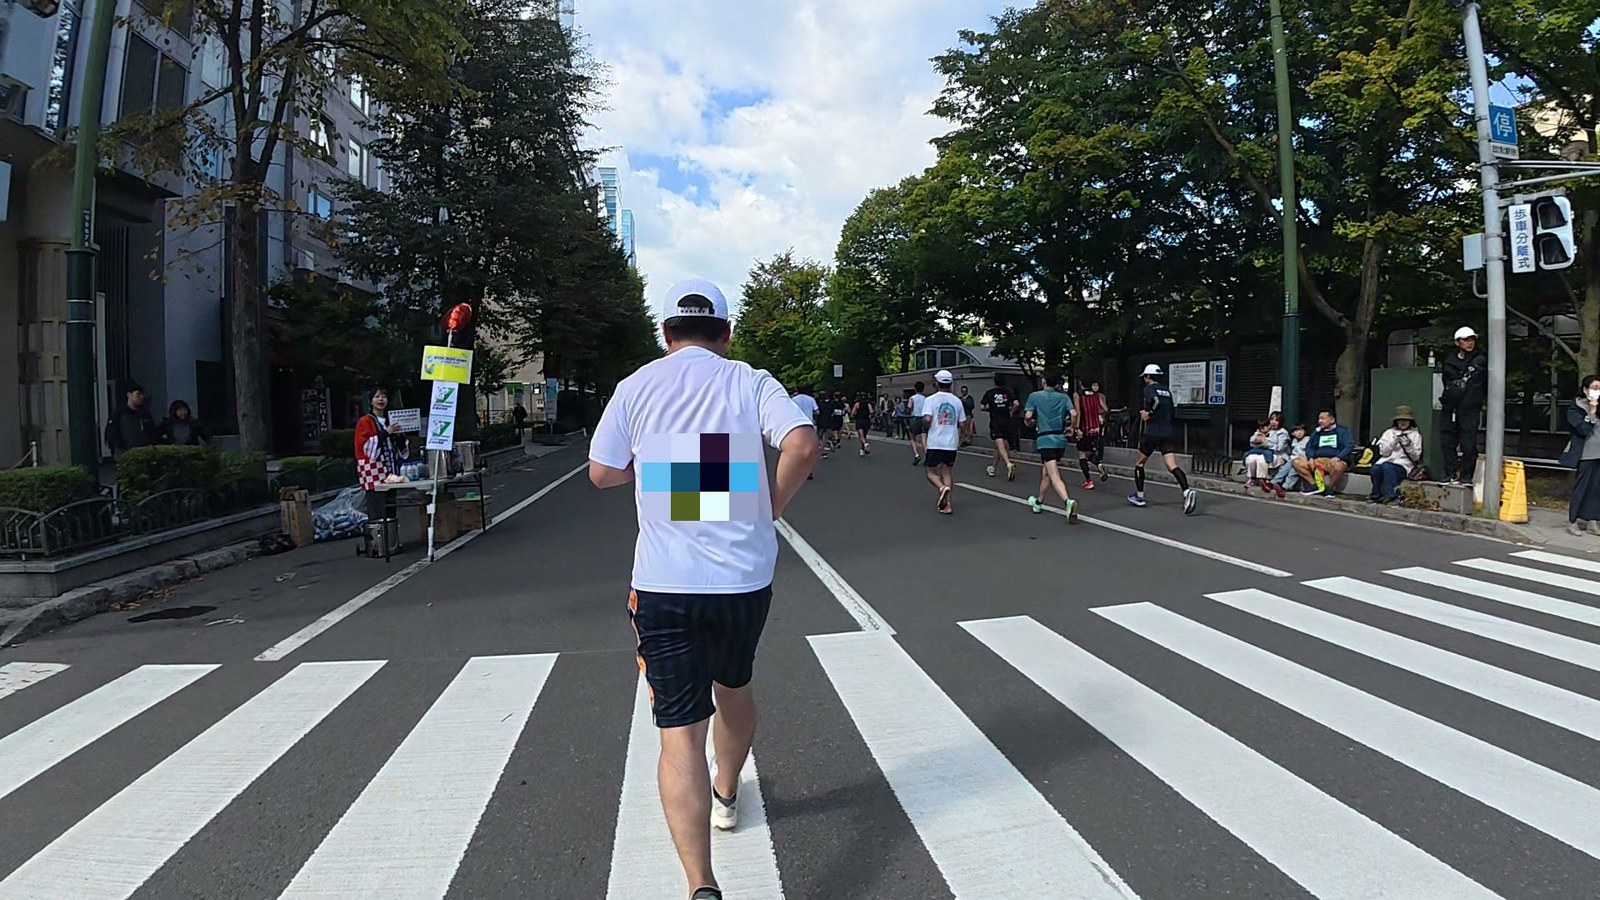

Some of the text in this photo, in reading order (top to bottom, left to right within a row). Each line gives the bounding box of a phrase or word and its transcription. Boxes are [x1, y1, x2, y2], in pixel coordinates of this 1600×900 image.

[1493, 112, 1512, 137] 停
[1514, 209, 1530, 269] 歩車分離式
